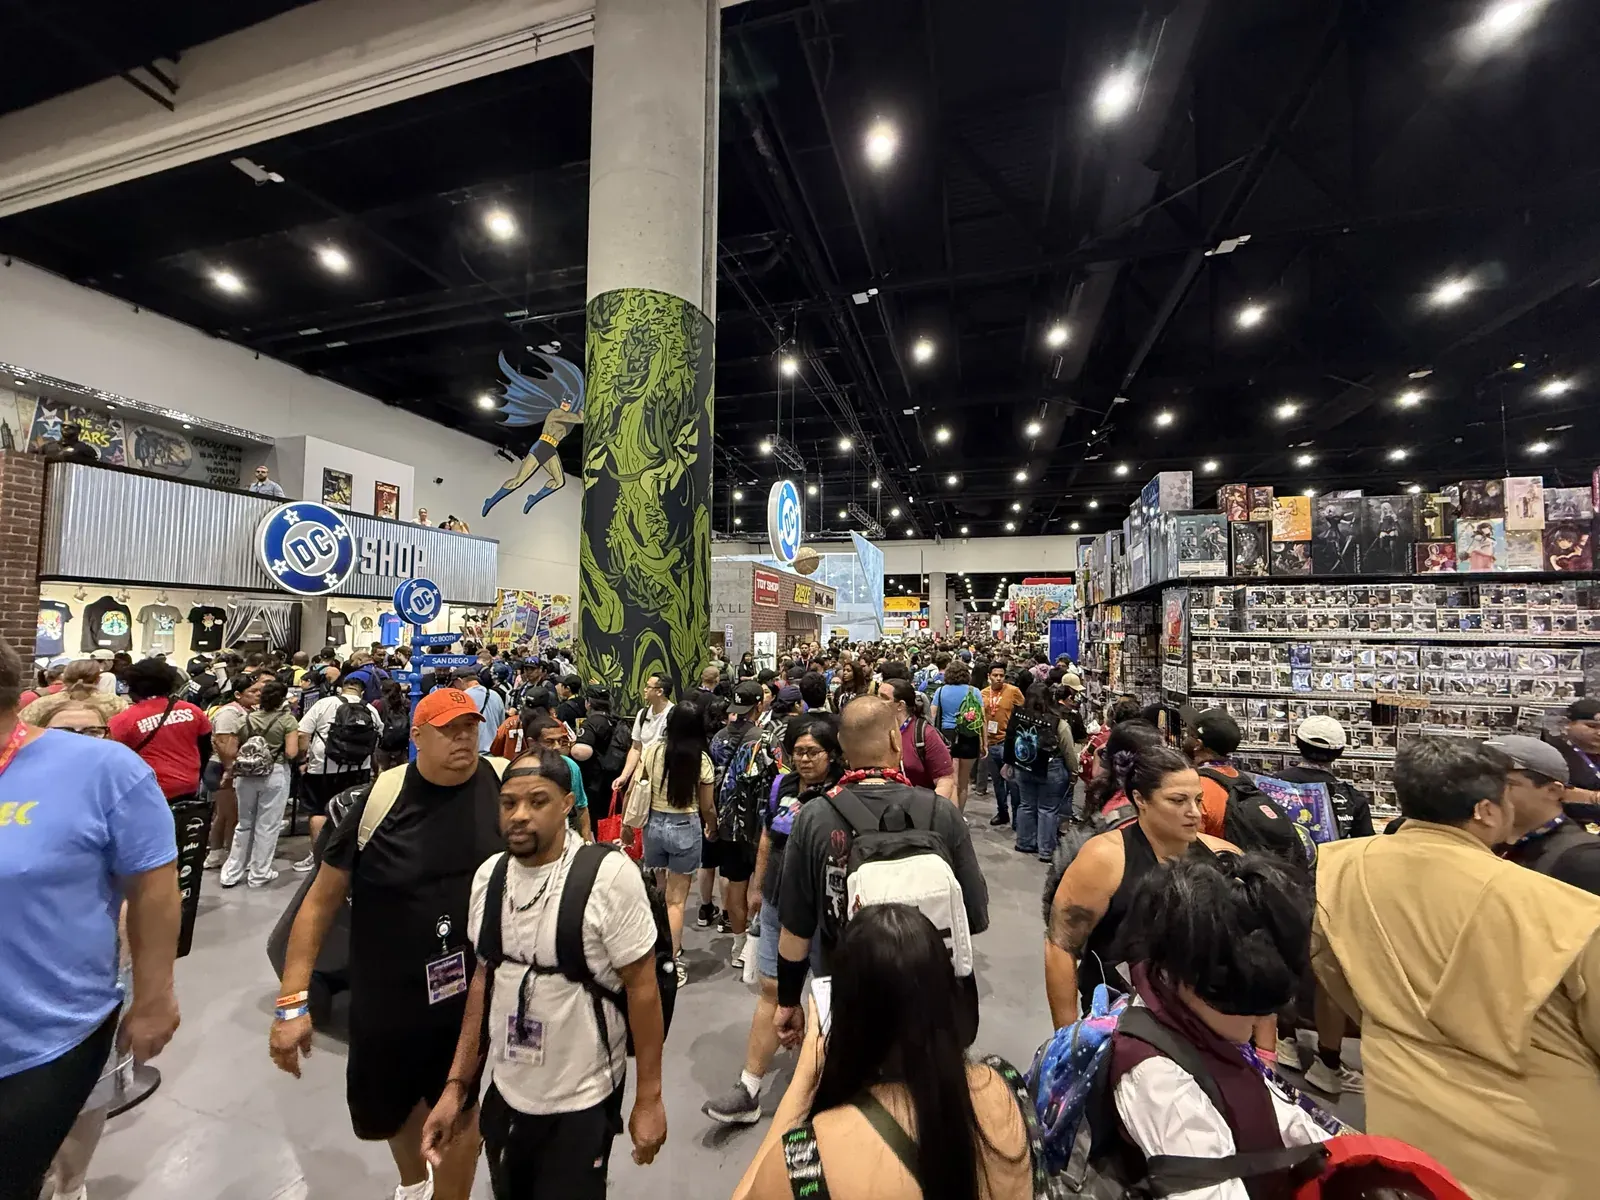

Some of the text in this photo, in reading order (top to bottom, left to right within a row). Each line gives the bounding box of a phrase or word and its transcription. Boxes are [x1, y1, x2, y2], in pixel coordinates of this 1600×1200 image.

[784, 505, 795, 538] DC
[286, 526, 335, 571] DC
[359, 536, 427, 579] SHOP
[757, 578, 767, 590] TOY
[766, 580, 779, 592] SHOP
[412, 590, 433, 612] DC
[438, 635, 456, 643] BOOTH
[431, 657, 447, 665] SAN
[447, 657, 469, 665] DIEGO
